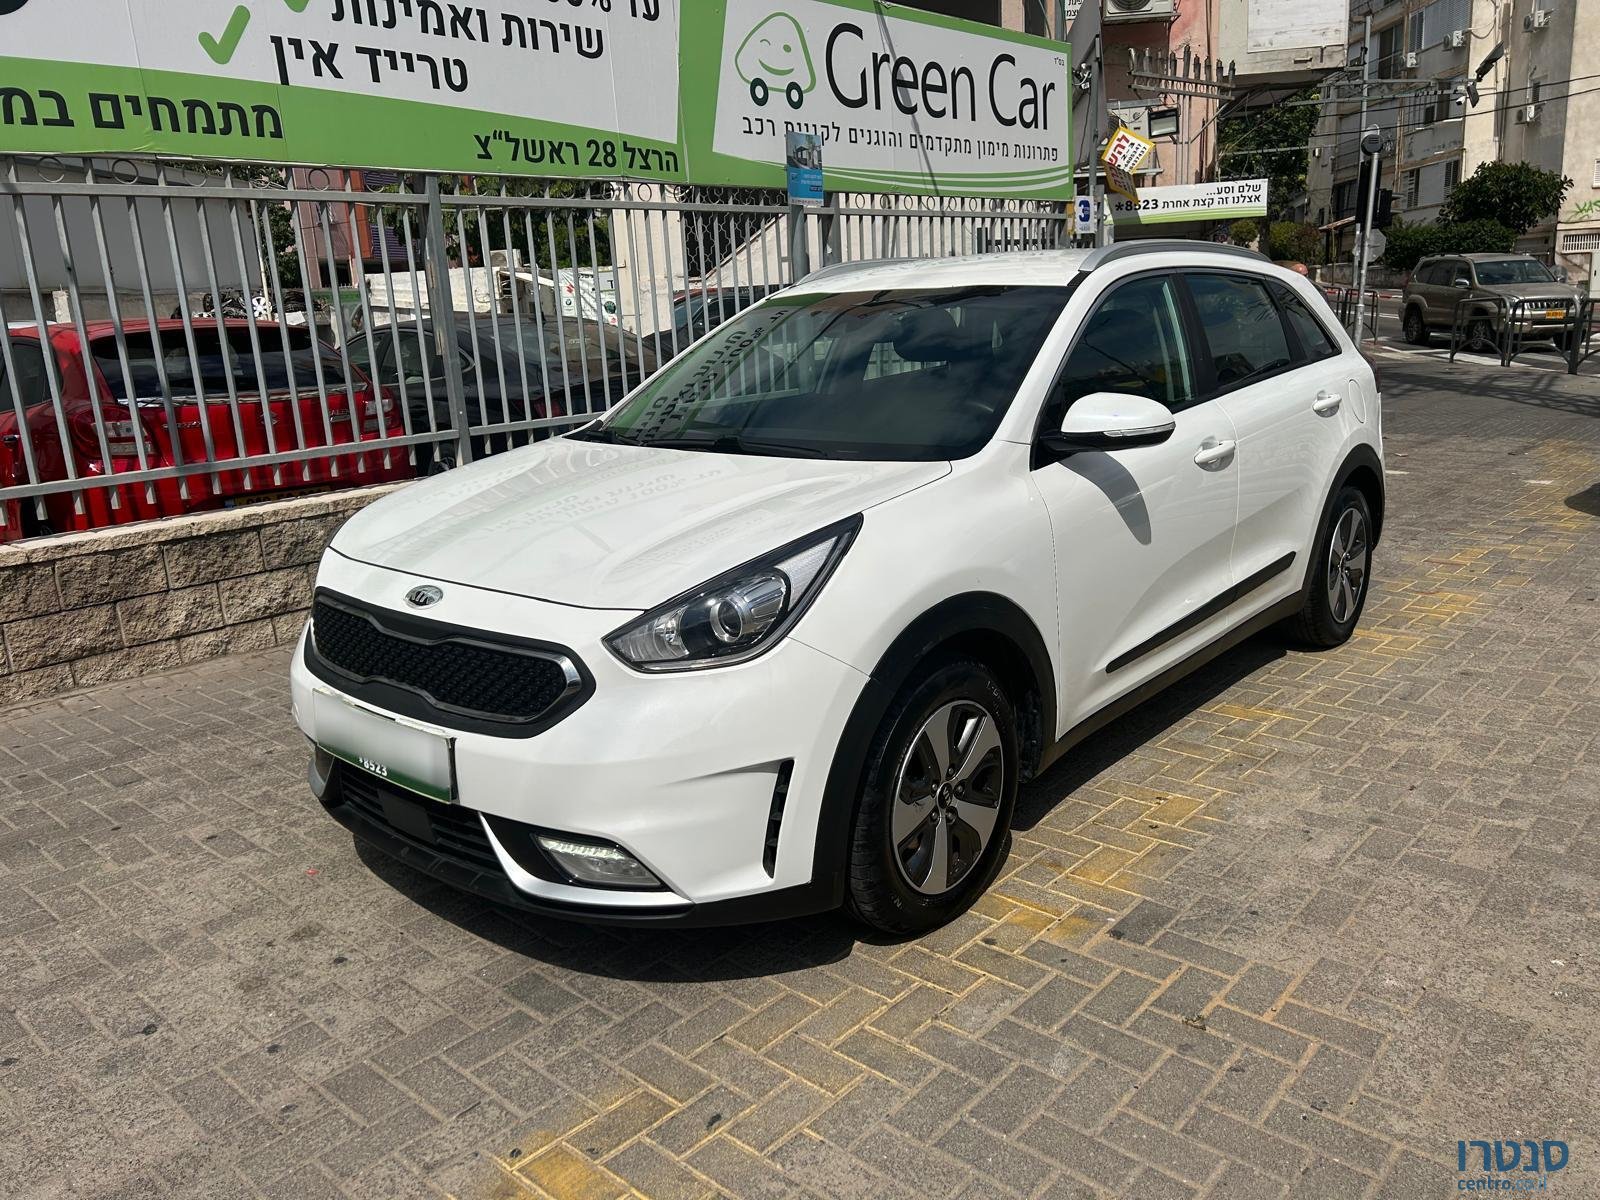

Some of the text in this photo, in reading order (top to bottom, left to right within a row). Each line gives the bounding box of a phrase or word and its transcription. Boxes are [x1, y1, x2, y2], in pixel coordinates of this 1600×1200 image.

[501, 13, 604, 59] שירות
[270, 35, 469, 92] טרייד אין
[826, 22, 1056, 131] Green Car
[88, 92, 283, 139] מתמחים
[742, 116, 776, 137] רכב
[849, 127, 902, 148] והוגנים
[909, 133, 972, 156] מתקדמים
[586, 138, 617, 168] 28
[622, 140, 679, 173] הרצל
[976, 140, 1009, 160] מימון
[1014, 143, 1058, 162] פתרונות
[1232, 193, 1262, 204] אצלנו
[1238, 182, 1262, 194] שלם
[1161, 199, 1190, 209] אחרת
[1193, 197, 1215, 207] קצת
[1217, 196, 1230, 206] זה
